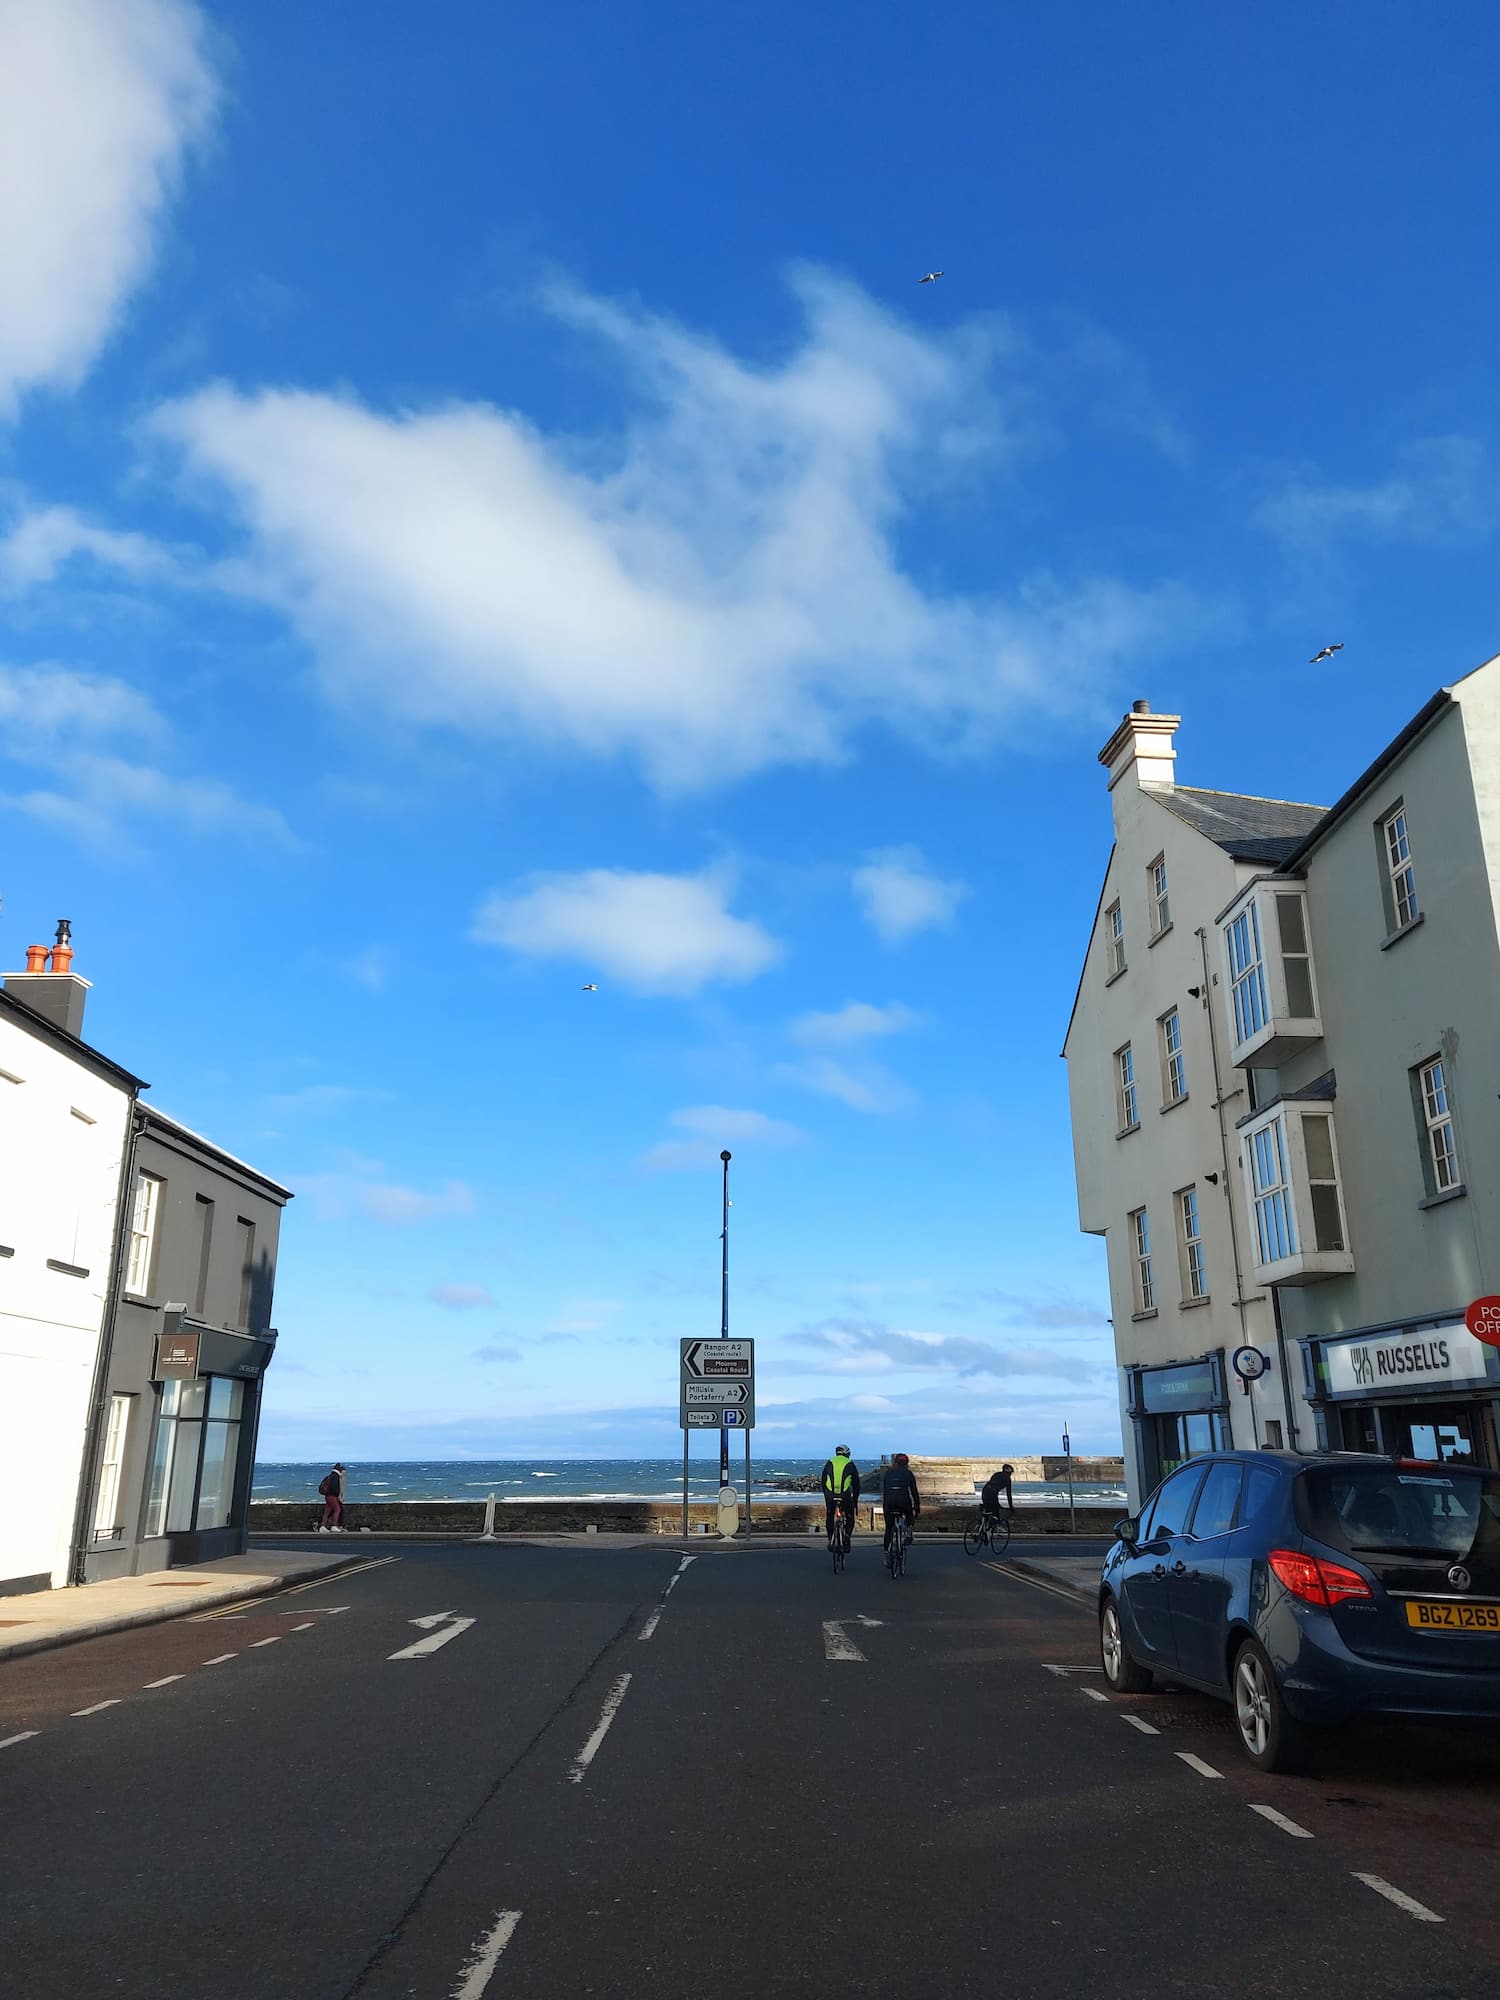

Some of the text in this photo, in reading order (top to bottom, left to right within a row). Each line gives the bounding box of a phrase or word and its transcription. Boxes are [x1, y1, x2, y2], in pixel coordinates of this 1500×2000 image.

[1375, 1340, 1450, 1376] RUSSELL'S
[727, 1412, 736, 1423] P
[1417, 1605, 1499, 1627] BGZ 1269
